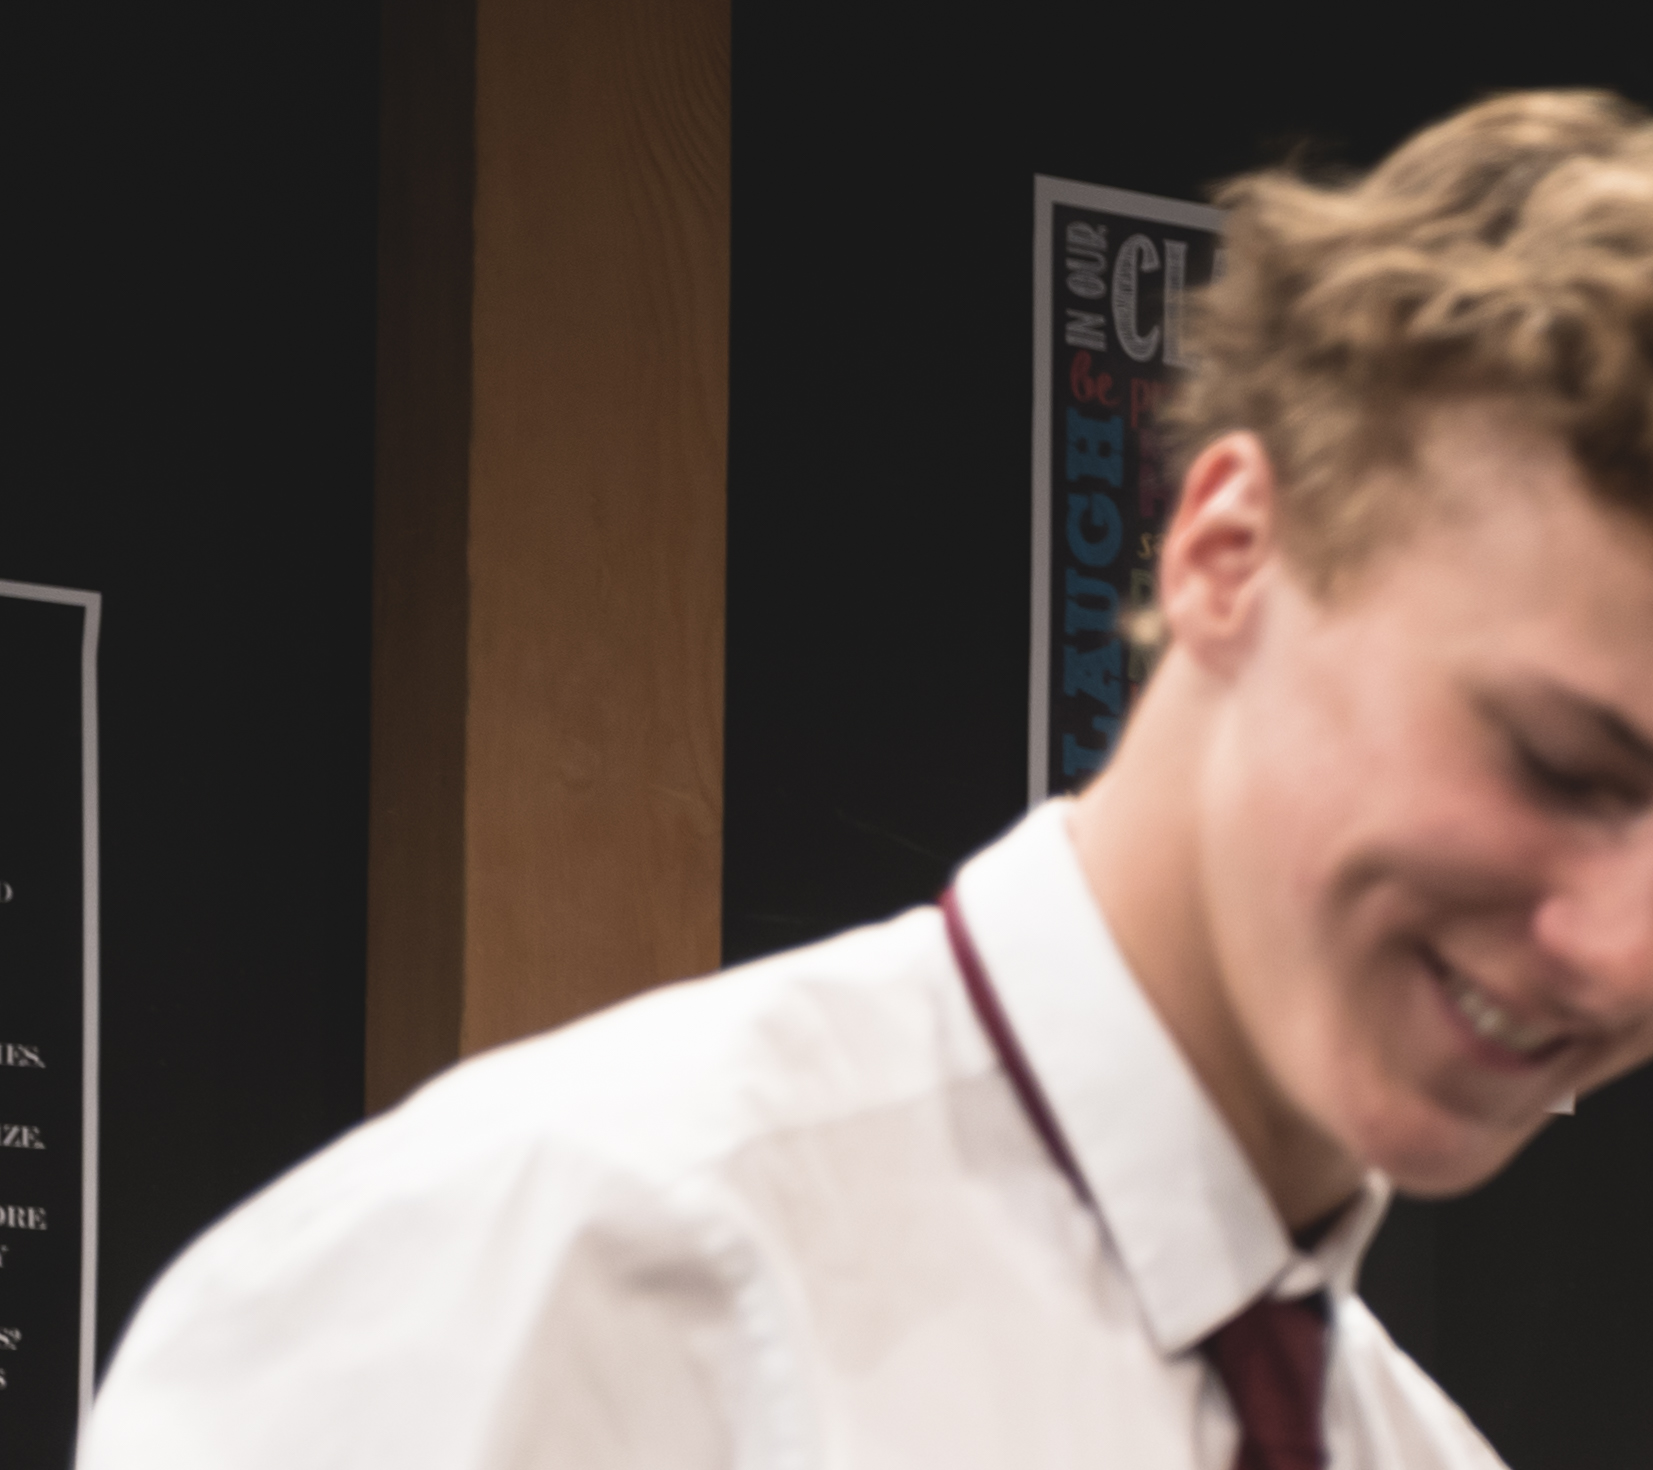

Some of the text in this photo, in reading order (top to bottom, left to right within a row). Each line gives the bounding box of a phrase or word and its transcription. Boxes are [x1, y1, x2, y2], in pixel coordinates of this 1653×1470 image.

[1065, 221, 1108, 351] IN OUR
[1070, 351, 1121, 408] be
[1064, 406, 1123, 777] LAUGH
